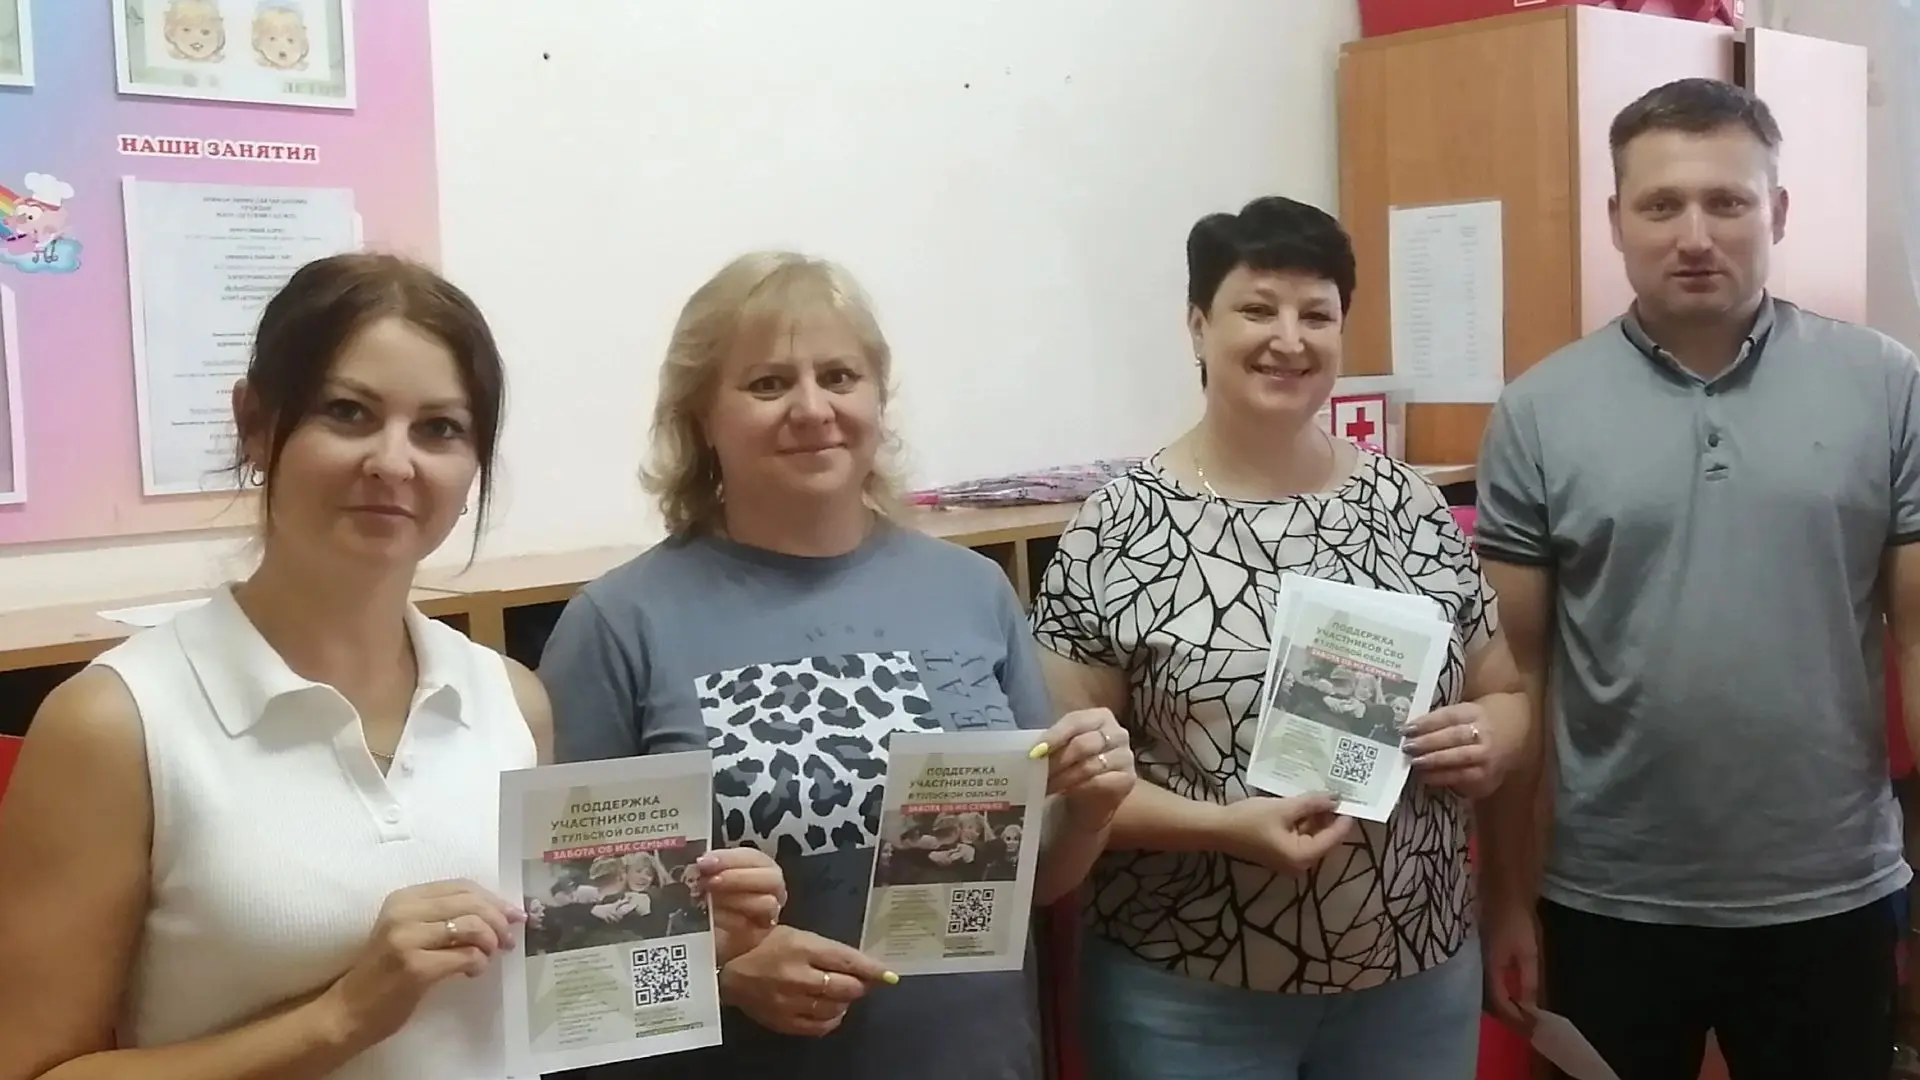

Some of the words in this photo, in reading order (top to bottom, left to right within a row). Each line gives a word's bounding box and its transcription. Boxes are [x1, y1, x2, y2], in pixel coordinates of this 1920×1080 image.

[120, 137, 200, 155] НАШИ
[207, 142, 317, 161] ЗАНЯТИЯ
[1316, 626, 1382, 653] УЧАСТНИКОВ
[1383, 648, 1405, 660] СВО
[1332, 621, 1395, 646] ПОДДЕРЖКА
[927, 766, 996, 777] ПОДДЕРЖКА
[909, 778, 984, 789] УЧАСТНИКОВ
[986, 777, 1009, 787] СВО
[570, 795, 661, 814] ПОДДЕРЖКА
[551, 811, 646, 831] УЧАСТНИКОВ
[650, 807, 680, 820] СВО
[551, 836, 559, 844] В
[562, 827, 623, 844] ТУЛЬСКОЙ
[625, 822, 680, 836] ОБЛАСТИ
[553, 847, 596, 860] ЗАБОТА
[597, 844, 614, 855] ОБ
[615, 842, 632, 853] ИХ
[632, 838, 678, 851] СЕМЬЯХ
